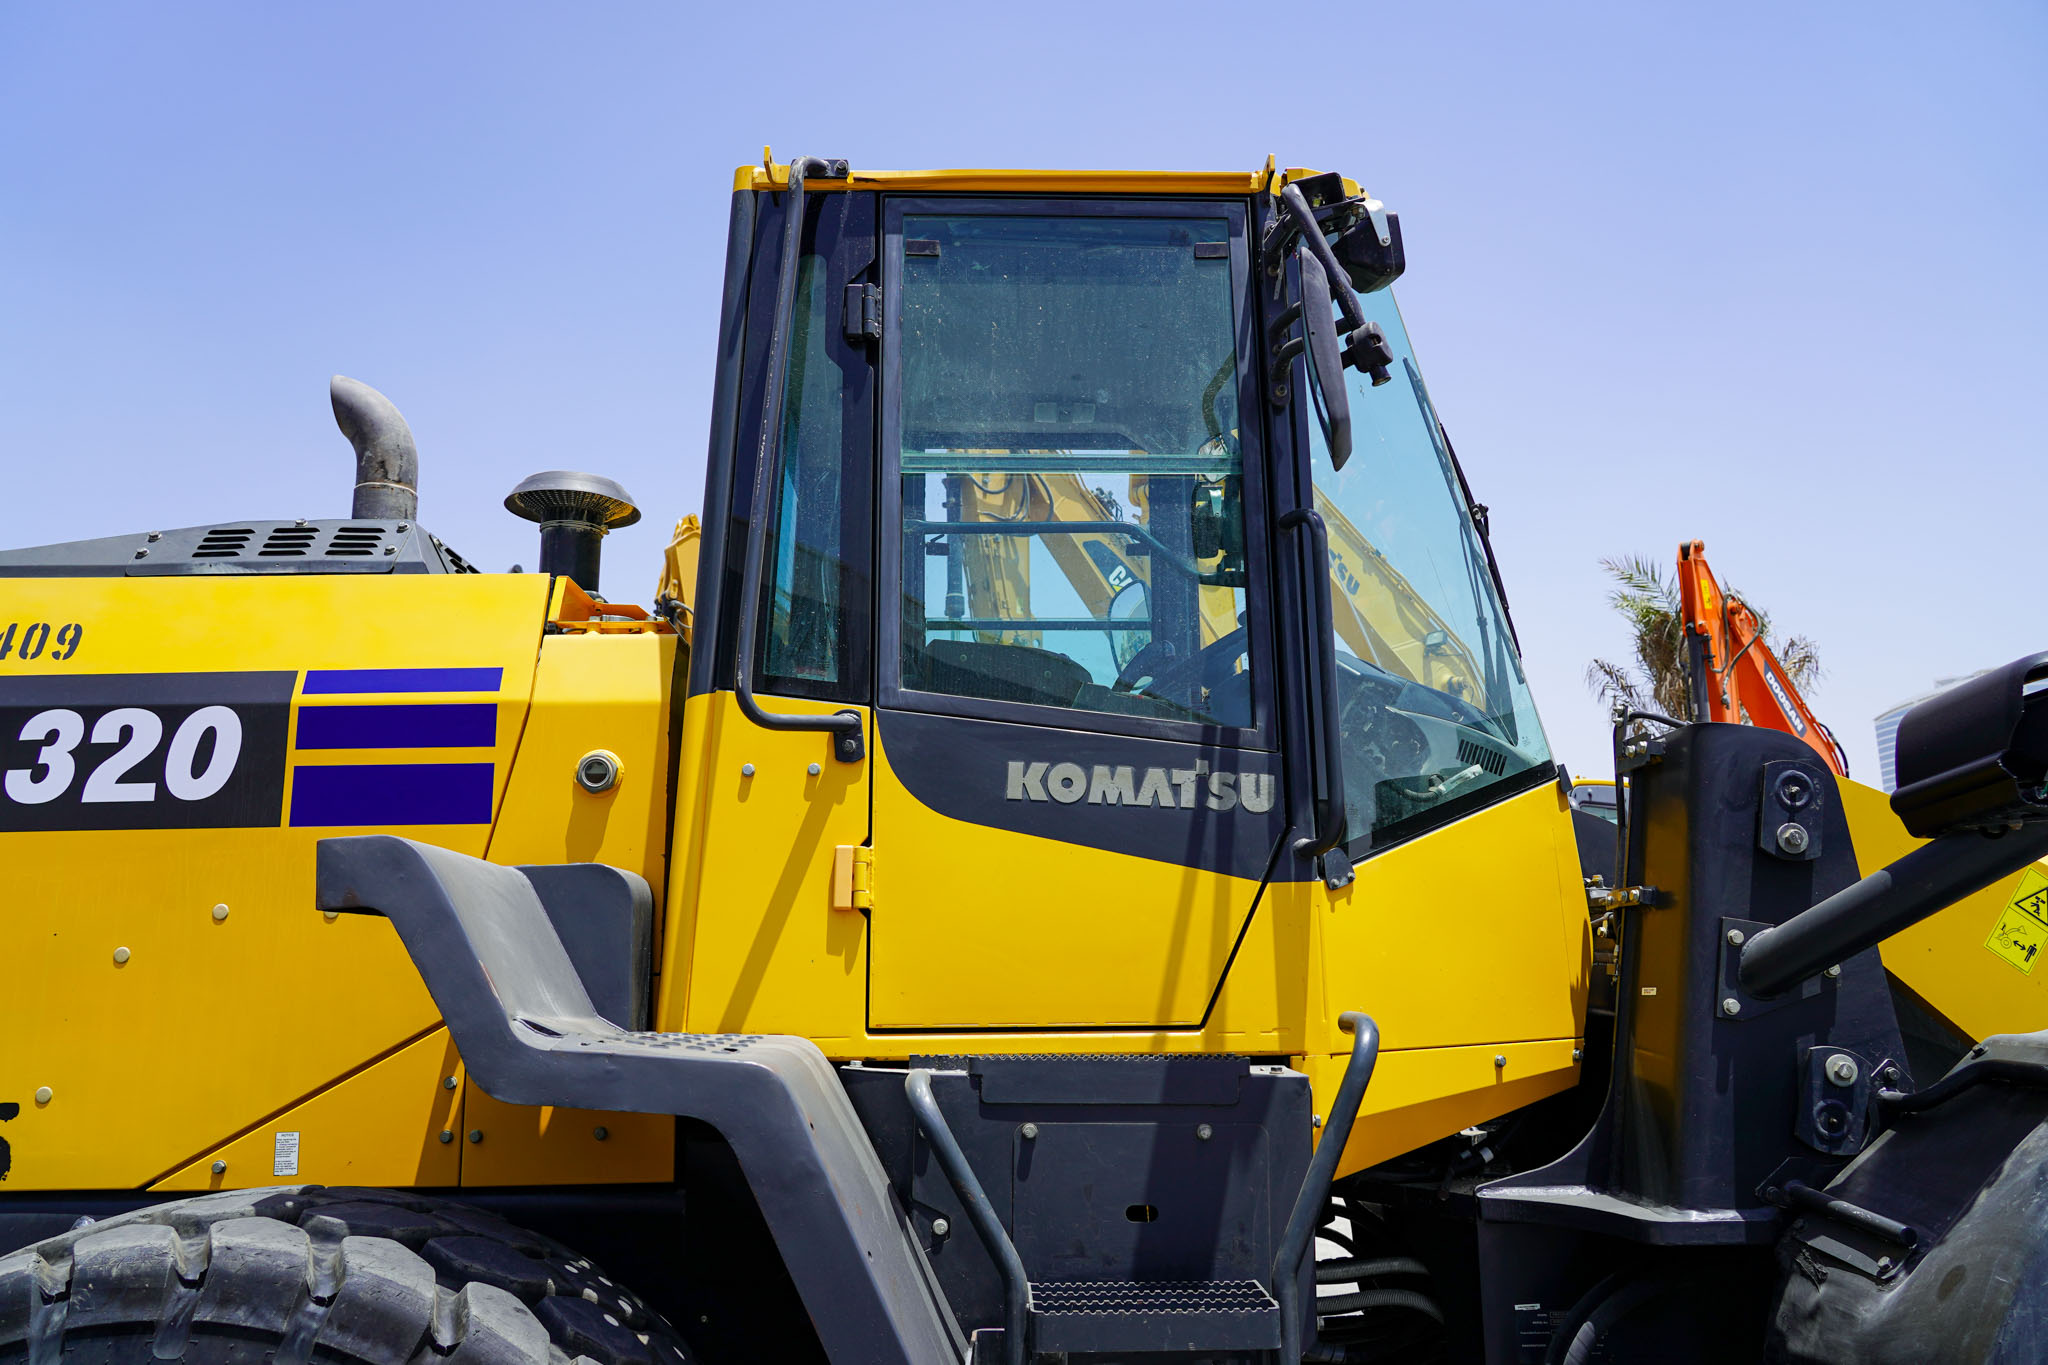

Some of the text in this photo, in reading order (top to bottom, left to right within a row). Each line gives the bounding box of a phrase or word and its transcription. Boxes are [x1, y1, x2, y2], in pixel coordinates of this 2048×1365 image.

[1766, 671, 1804, 732] DOOSAN
[4, 705, 242, 805] 320
[1006, 758, 1275, 815] KOMATSU
